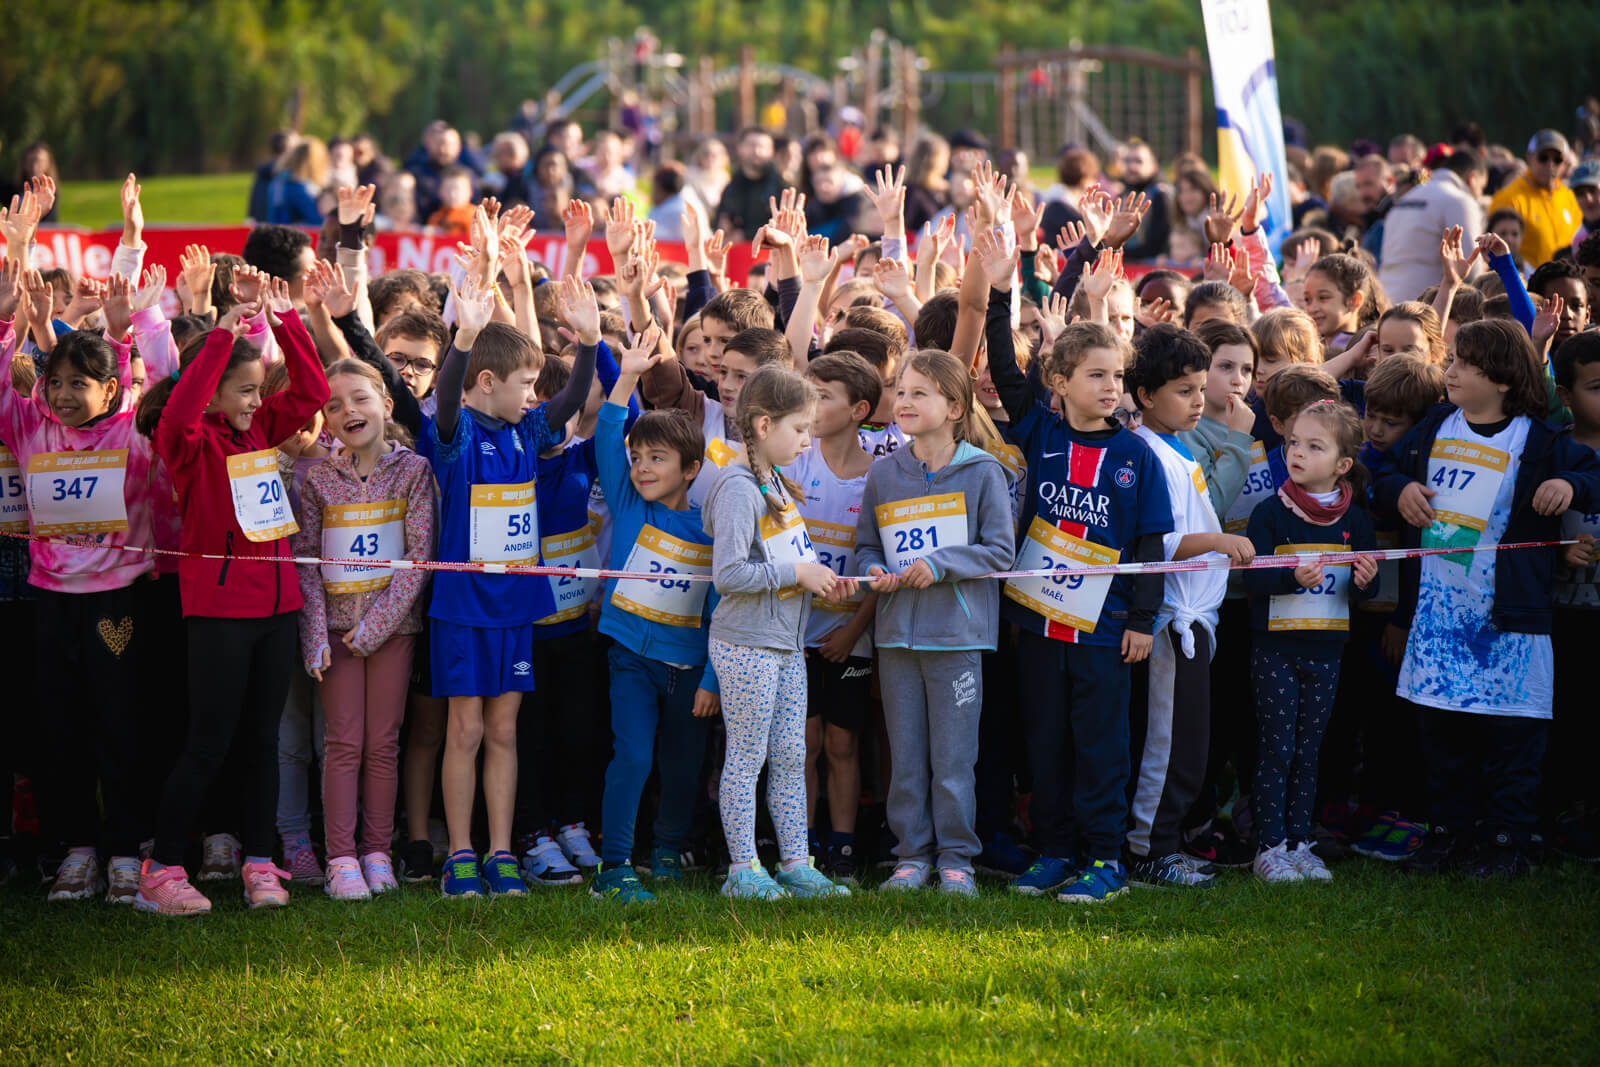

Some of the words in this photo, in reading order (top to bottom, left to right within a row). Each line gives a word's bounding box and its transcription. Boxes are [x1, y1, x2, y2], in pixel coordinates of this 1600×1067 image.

[52, 476, 98, 501] 347
[1431, 466, 1476, 490] 417
[1039, 482, 1110, 515] QATAR
[507, 512, 531, 537] 58
[1050, 503, 1109, 528] AIRWAYS
[350, 533, 379, 556] 43
[504, 541, 533, 552] ANDREA
[895, 525, 938, 553] 281
[557, 560, 583, 586] 24
[559, 588, 585, 601] NOVAK
[1041, 586, 1066, 603] MAËL
